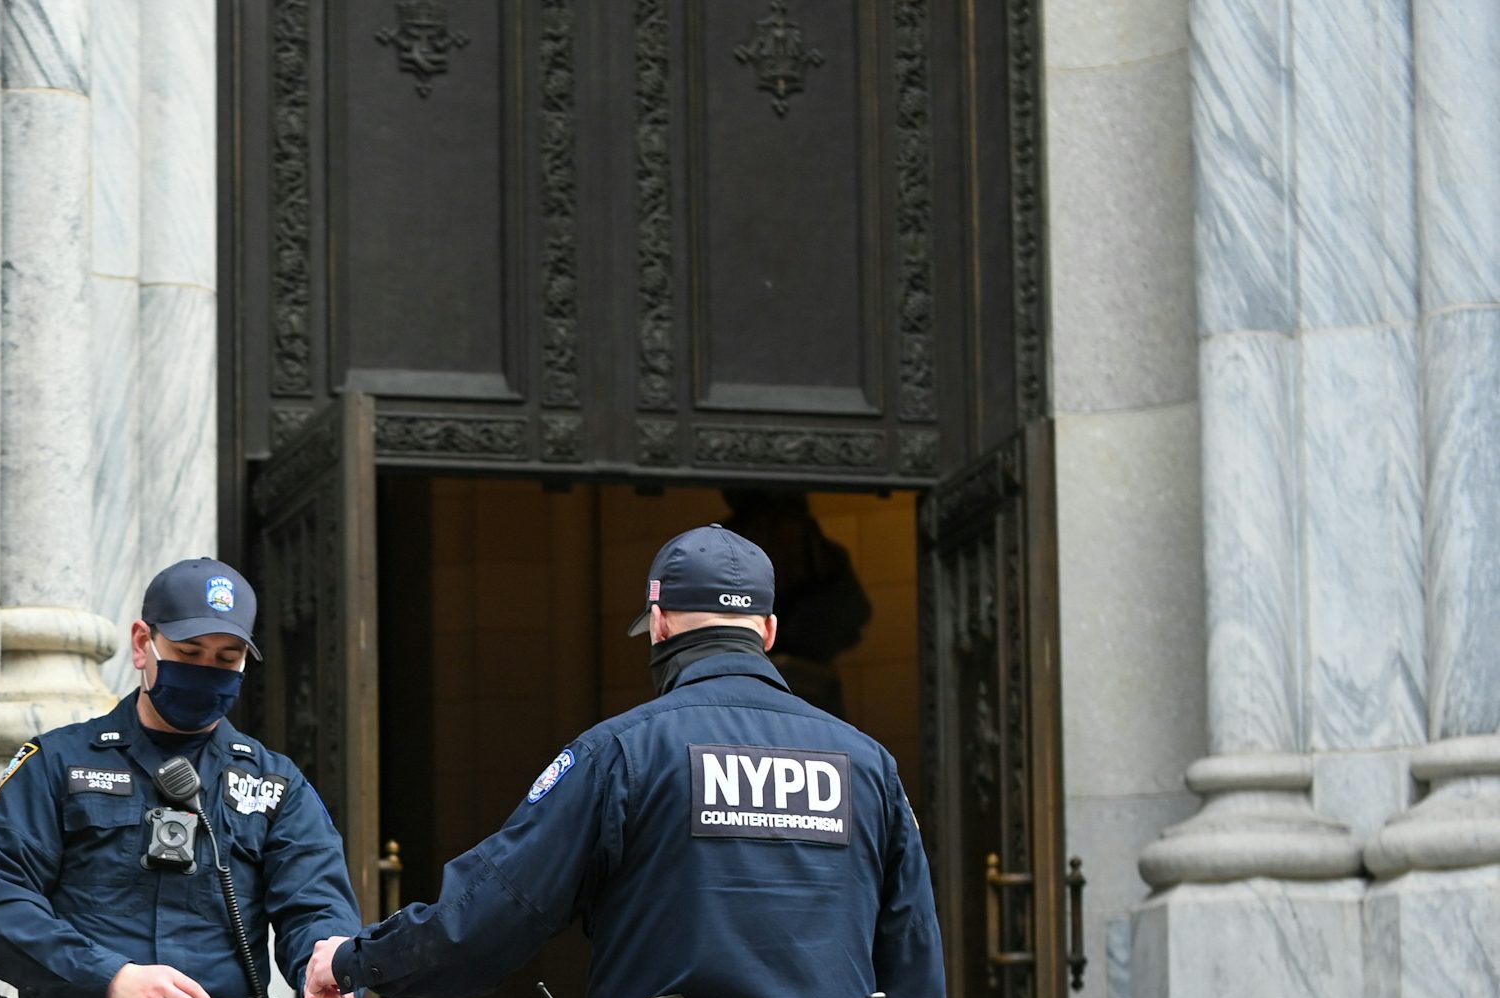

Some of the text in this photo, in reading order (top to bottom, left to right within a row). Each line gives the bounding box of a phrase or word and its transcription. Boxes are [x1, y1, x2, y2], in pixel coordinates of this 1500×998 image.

[718, 593, 752, 608] CRC
[100, 732, 120, 741] CTB
[70, 770, 131, 783] ST. JACQUES
[702, 753, 842, 812] NYPD
[88, 779, 113, 790] 2433
[227, 771, 285, 803] POLICE
[700, 810, 843, 833] COUNTERTERRORISM
